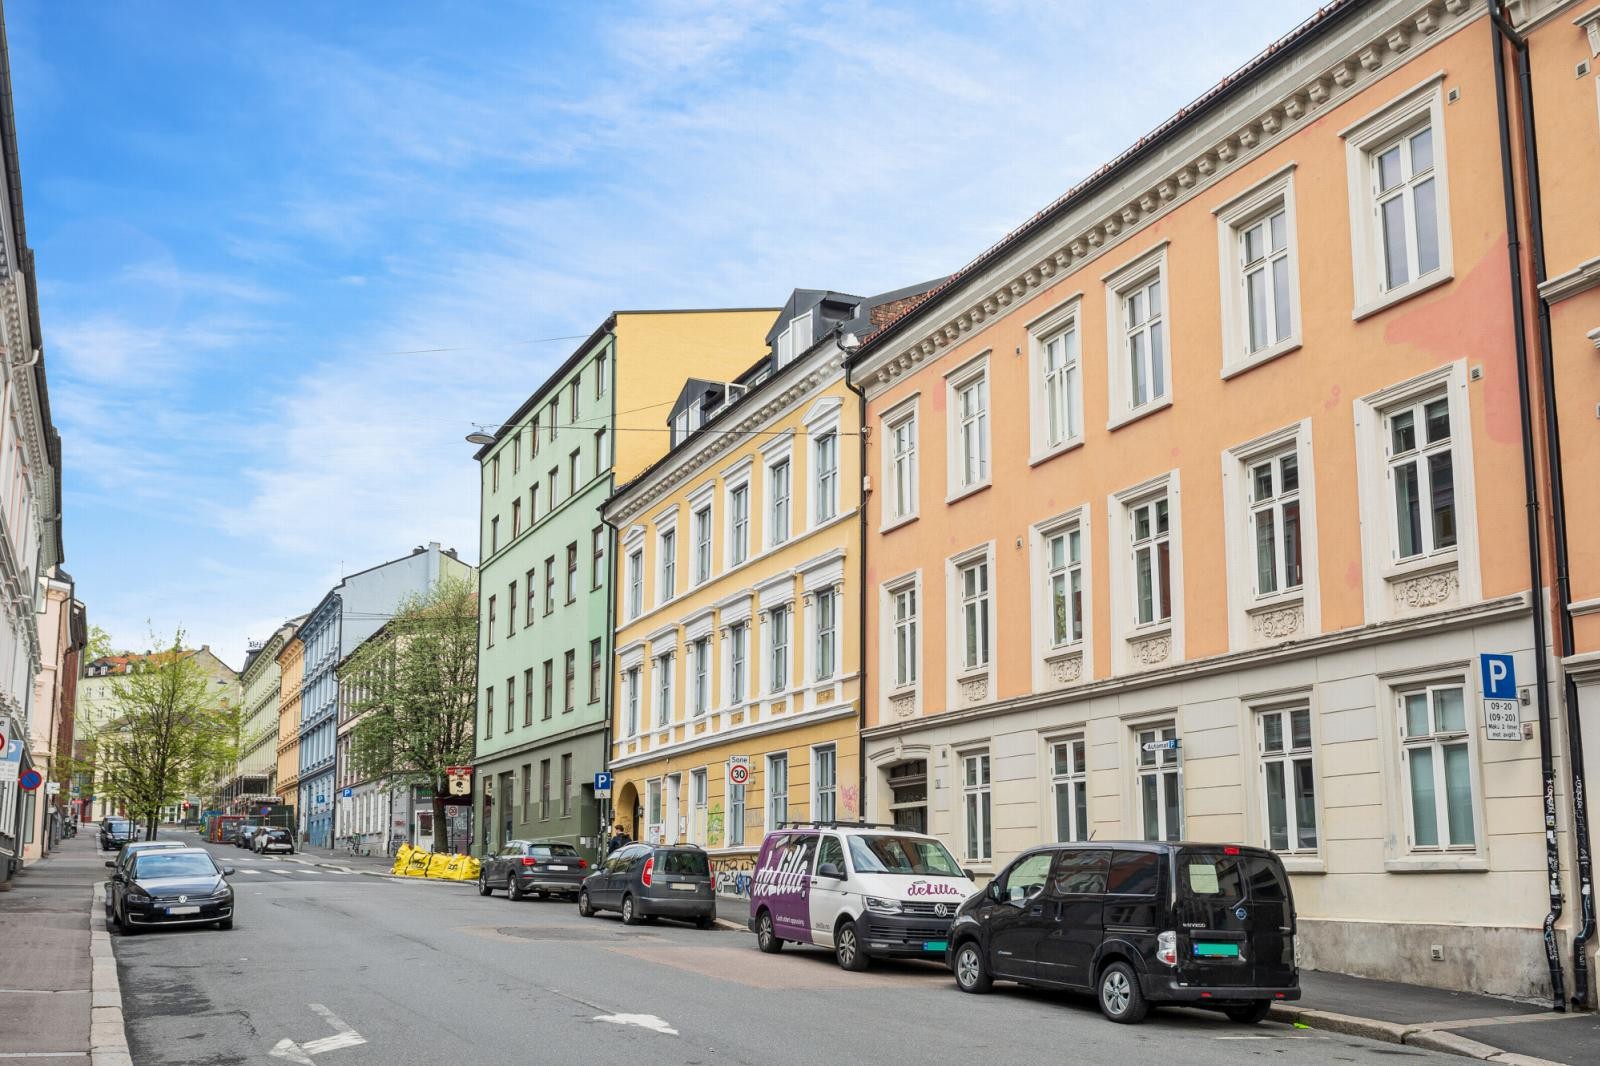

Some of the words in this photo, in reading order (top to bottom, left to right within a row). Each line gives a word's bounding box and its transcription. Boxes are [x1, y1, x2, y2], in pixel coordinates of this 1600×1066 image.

[1489, 660, 1507, 693] P
[1490, 702, 1512, 711] 09-20
[1489, 713, 1516, 722] (09-20)
[731, 756, 748, 764] Sone
[734, 769, 746, 779] 30
[598, 774, 607, 788] P
